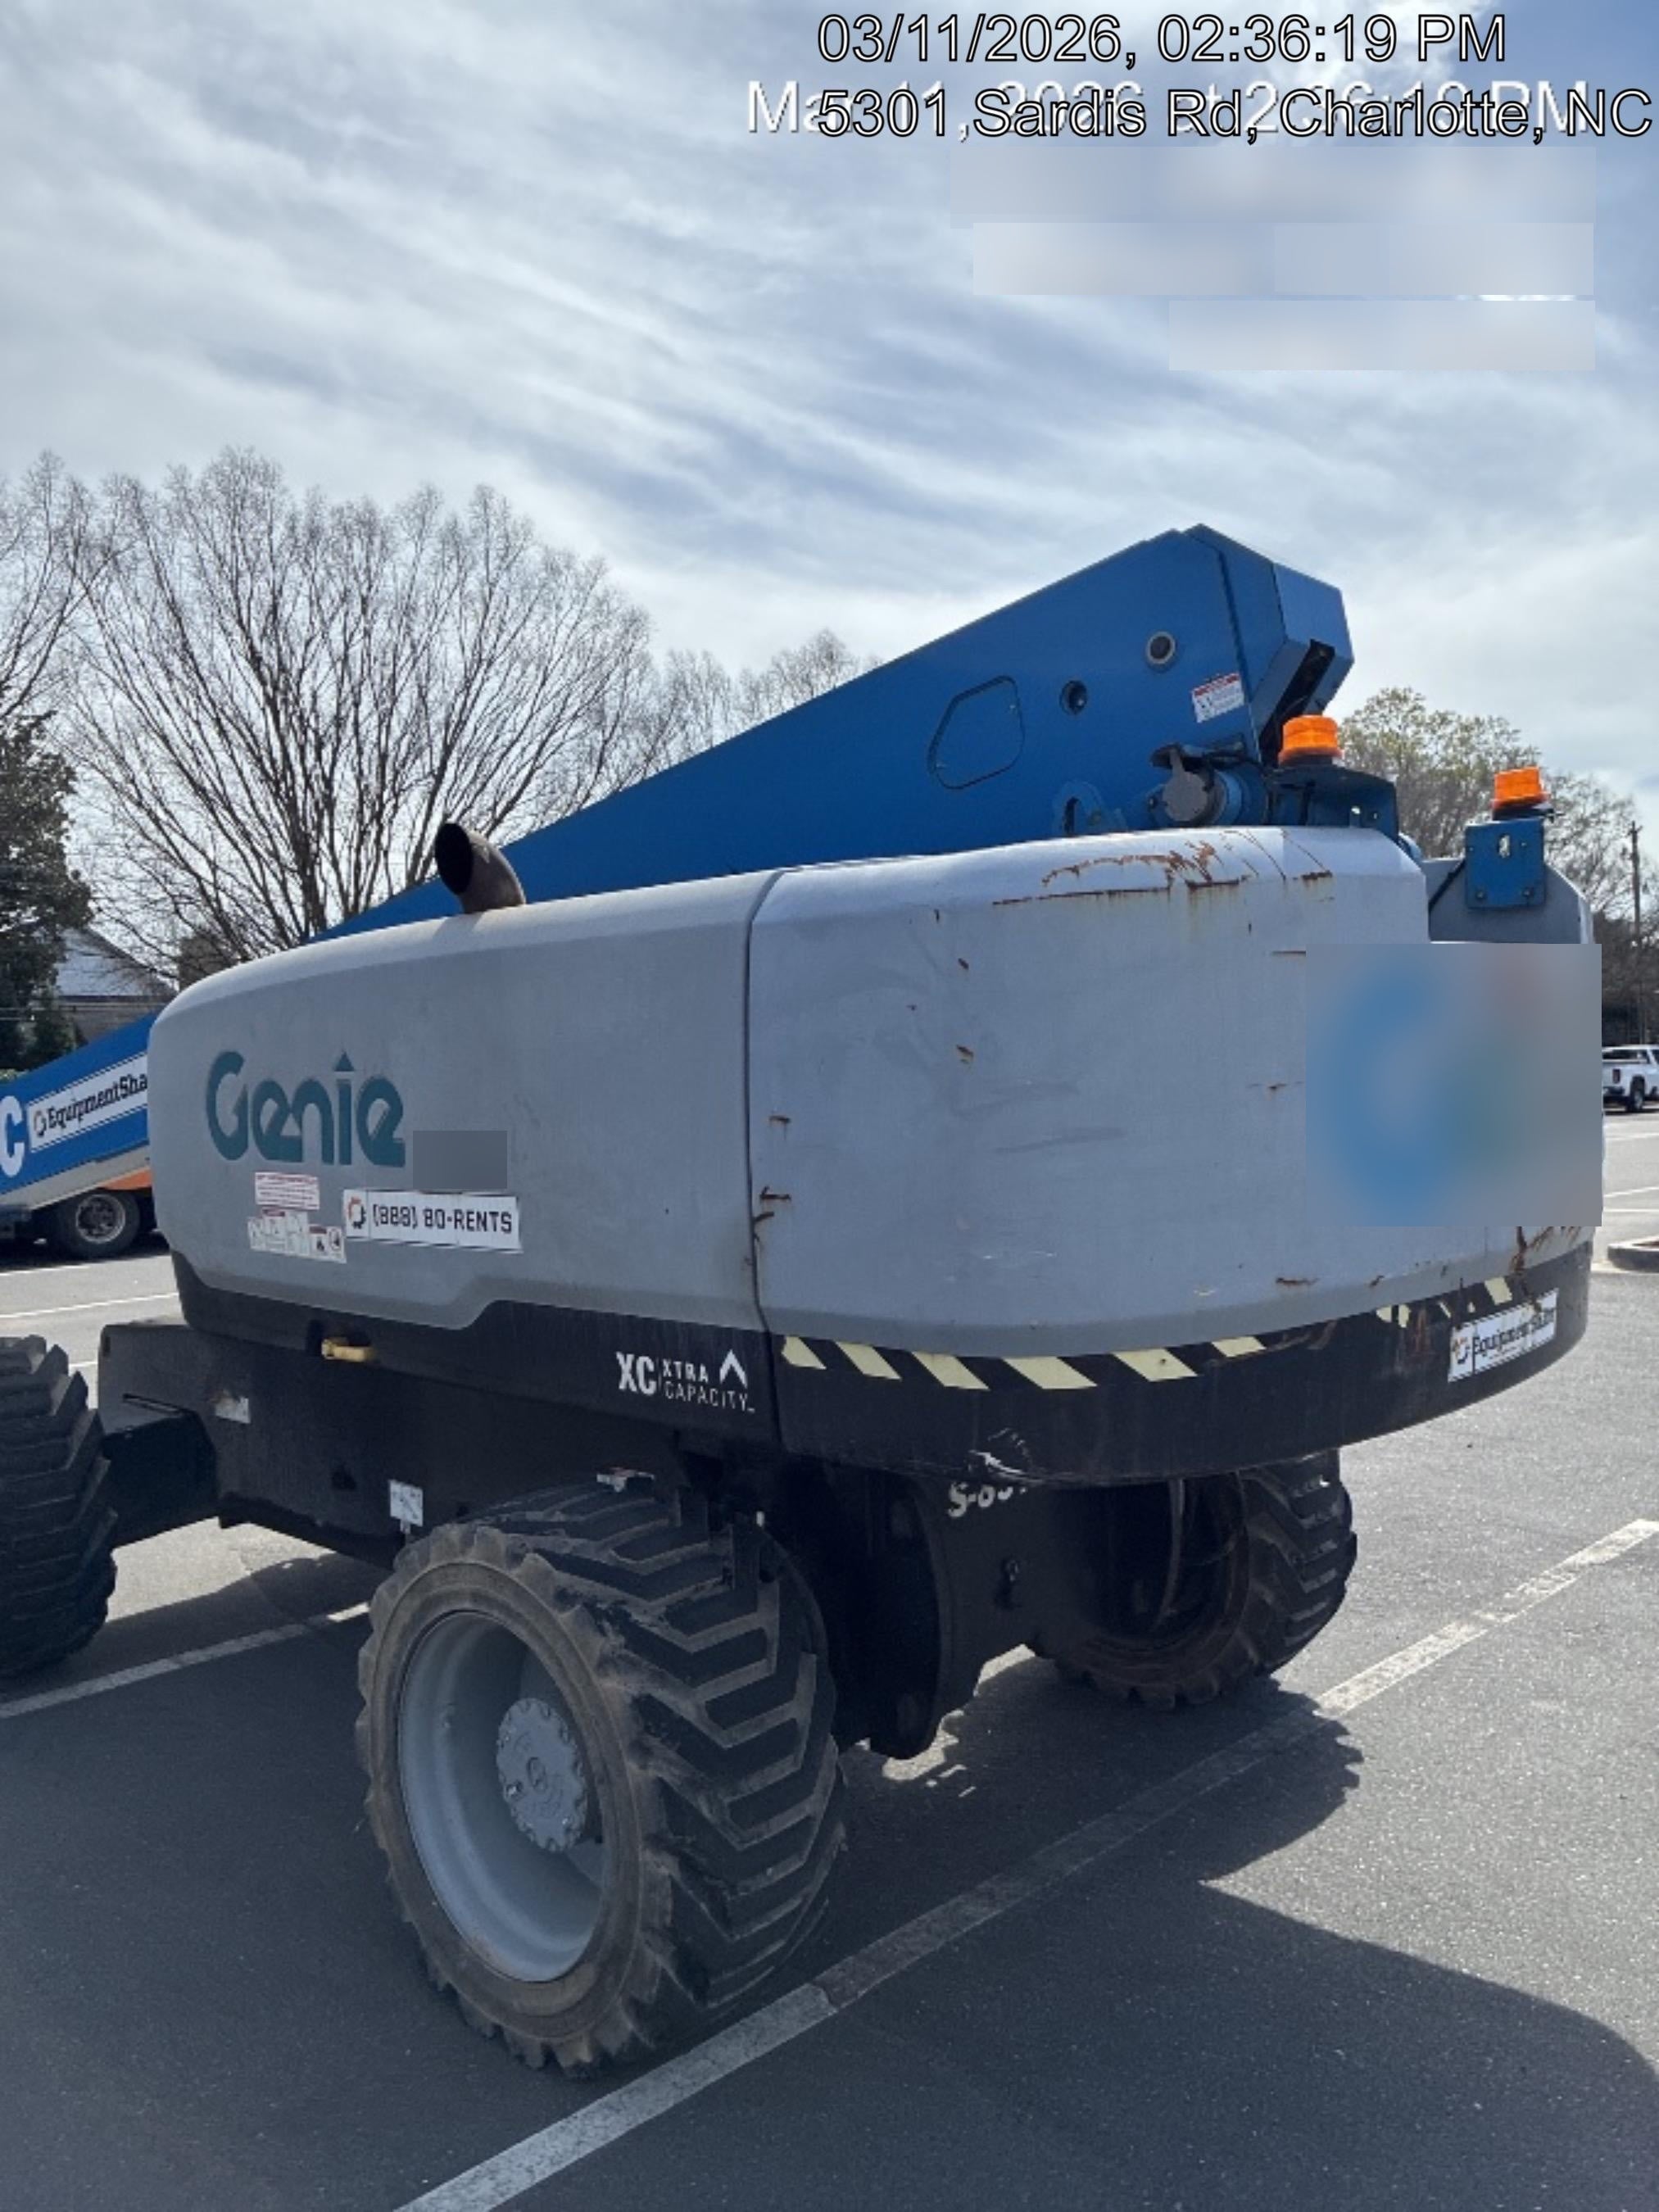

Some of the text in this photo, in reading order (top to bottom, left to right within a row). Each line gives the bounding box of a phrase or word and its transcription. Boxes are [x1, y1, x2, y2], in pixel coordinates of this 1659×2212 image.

[206, 1051, 406, 1168] Genie
[373, 1204, 418, 1229] (888)
[616, 1351, 656, 1395] XC
[662, 1358, 709, 1384] XTRA
[664, 1380, 749, 1412] CAPACITY
